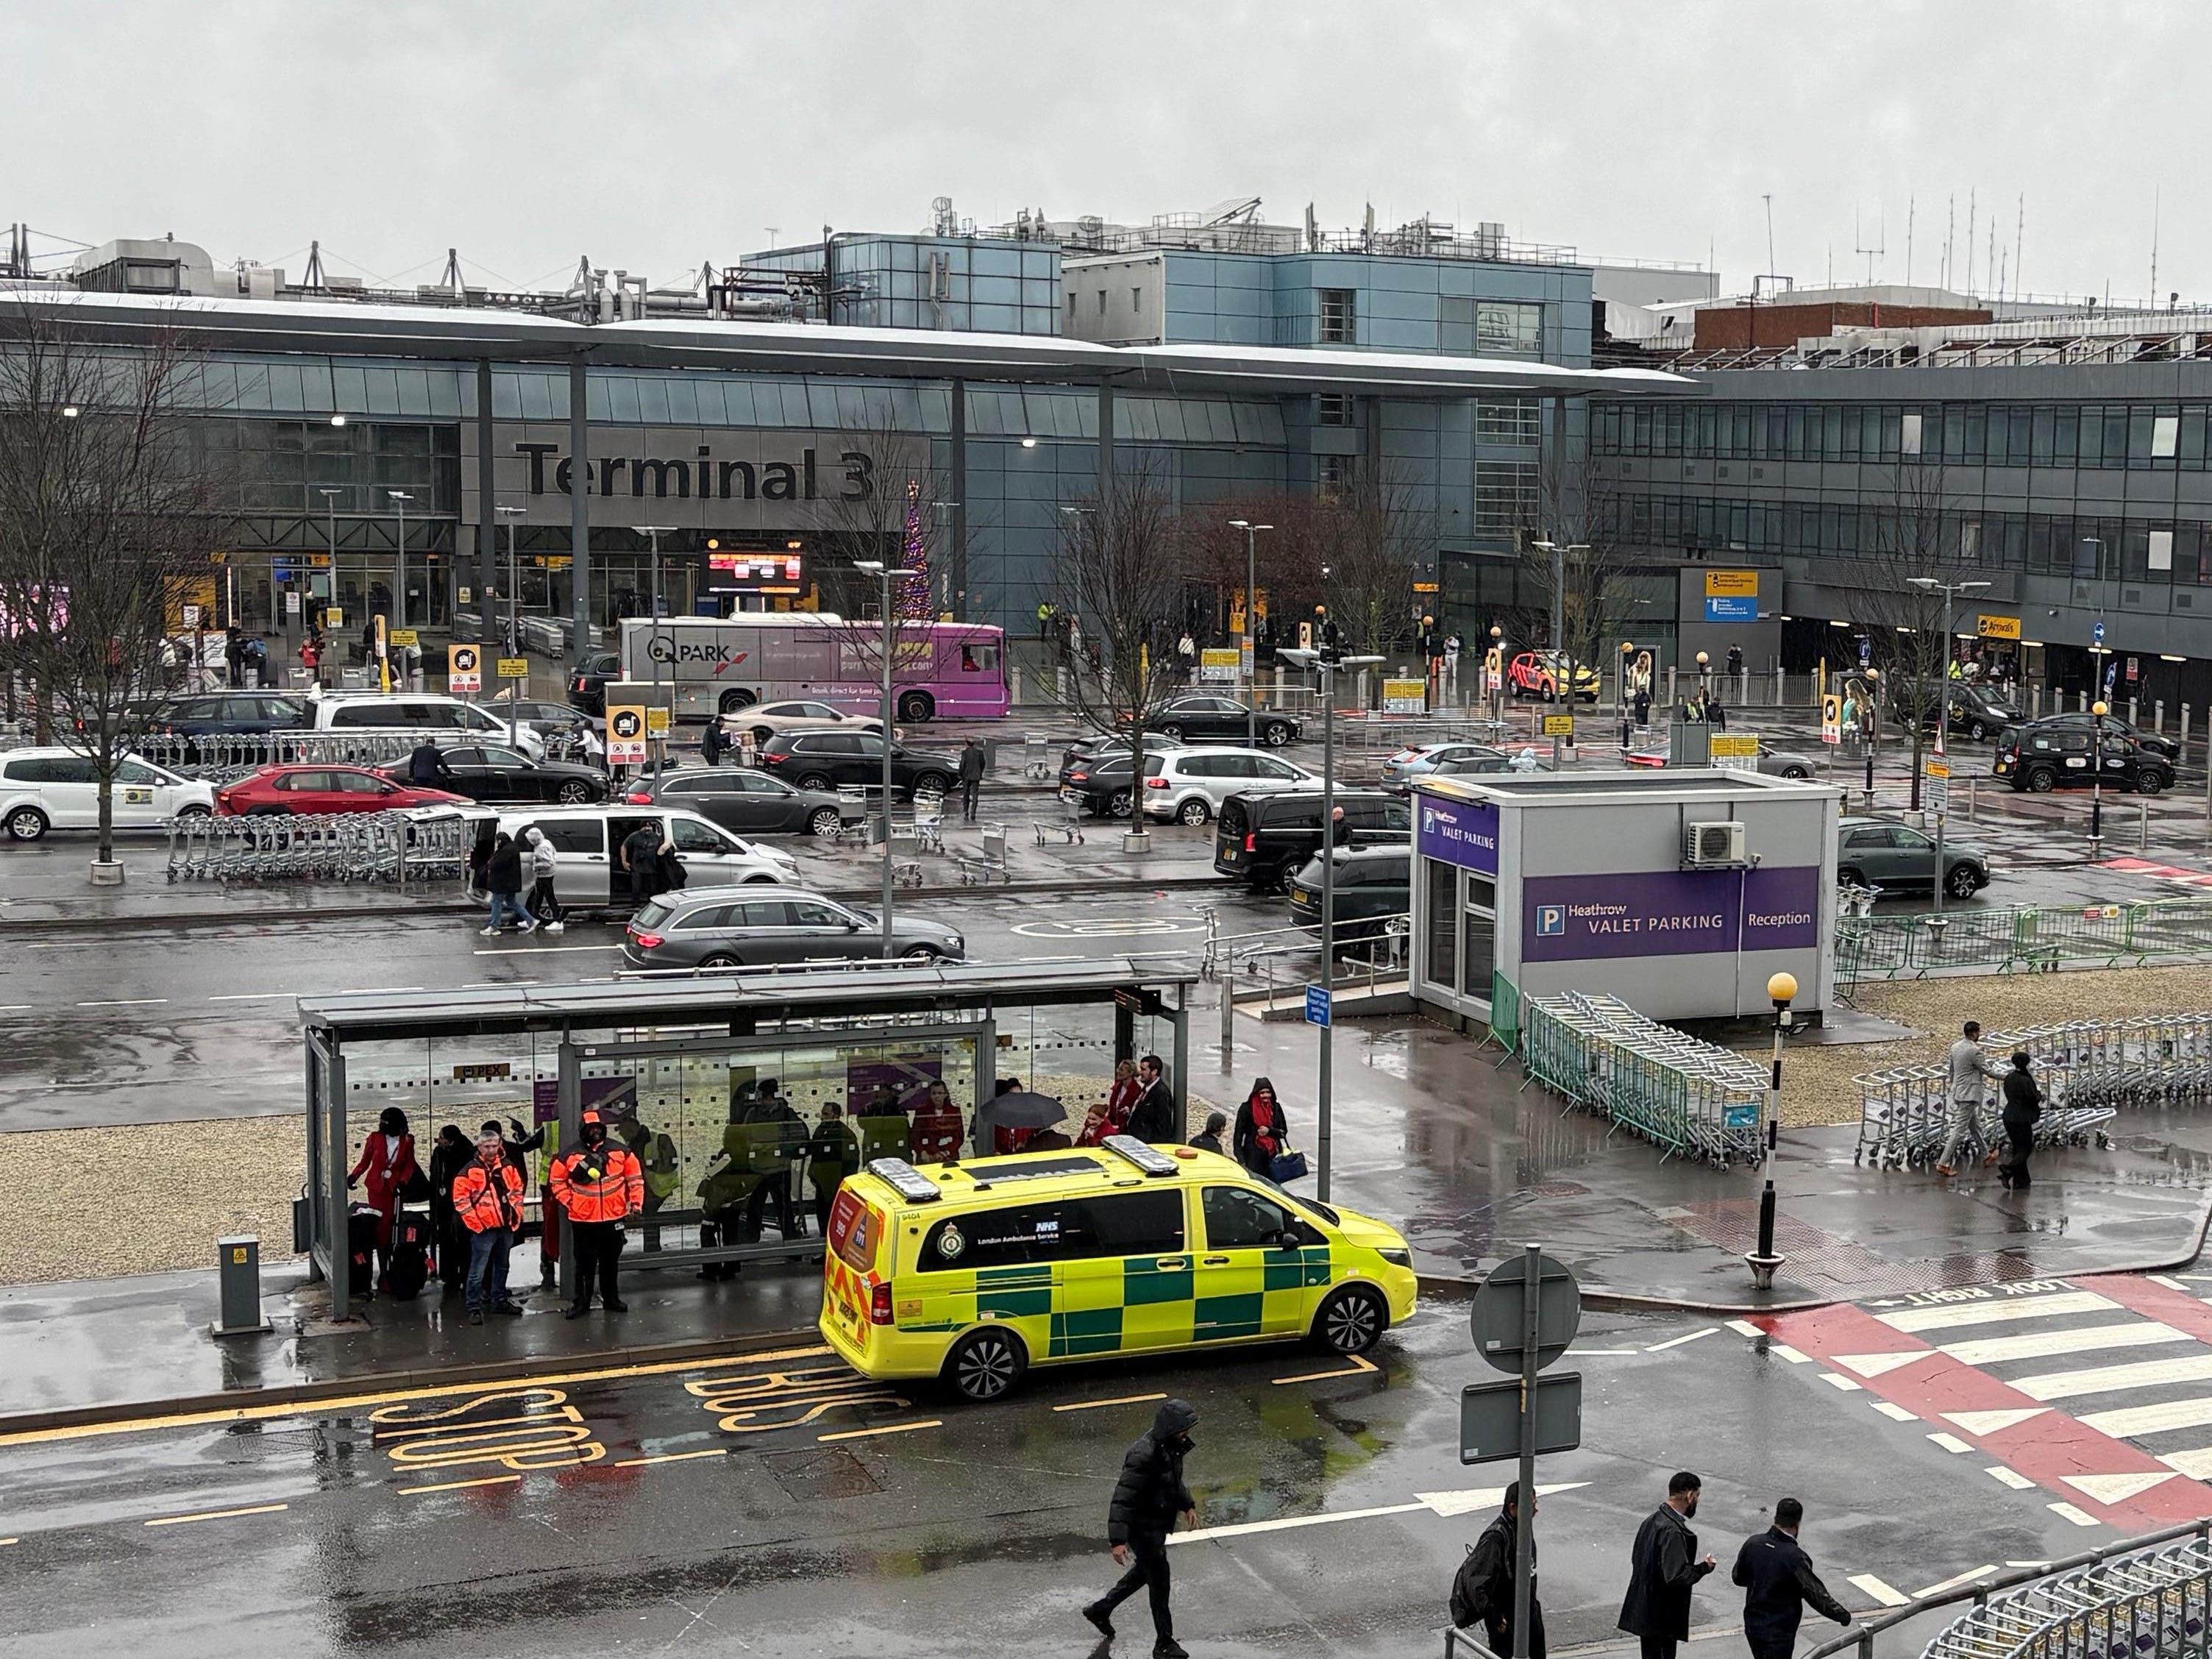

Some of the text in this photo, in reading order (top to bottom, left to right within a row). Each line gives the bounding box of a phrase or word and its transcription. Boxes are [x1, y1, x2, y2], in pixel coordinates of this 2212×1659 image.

[516, 443, 874, 502] Terminal 3
[680, 644, 730, 661] PARK
[1442, 825, 1494, 849] VALET PARKING
[1568, 903, 1627, 917] Heathrow
[1749, 912, 1810, 927] Reception
[1589, 914, 1723, 934] VALET PARKING
[1036, 1221, 1058, 1232] NHS
[1905, 1278, 2076, 1306] LOOK RIGHT
[684, 1364, 912, 1432] BUS
[368, 1388, 607, 1471] STOP
